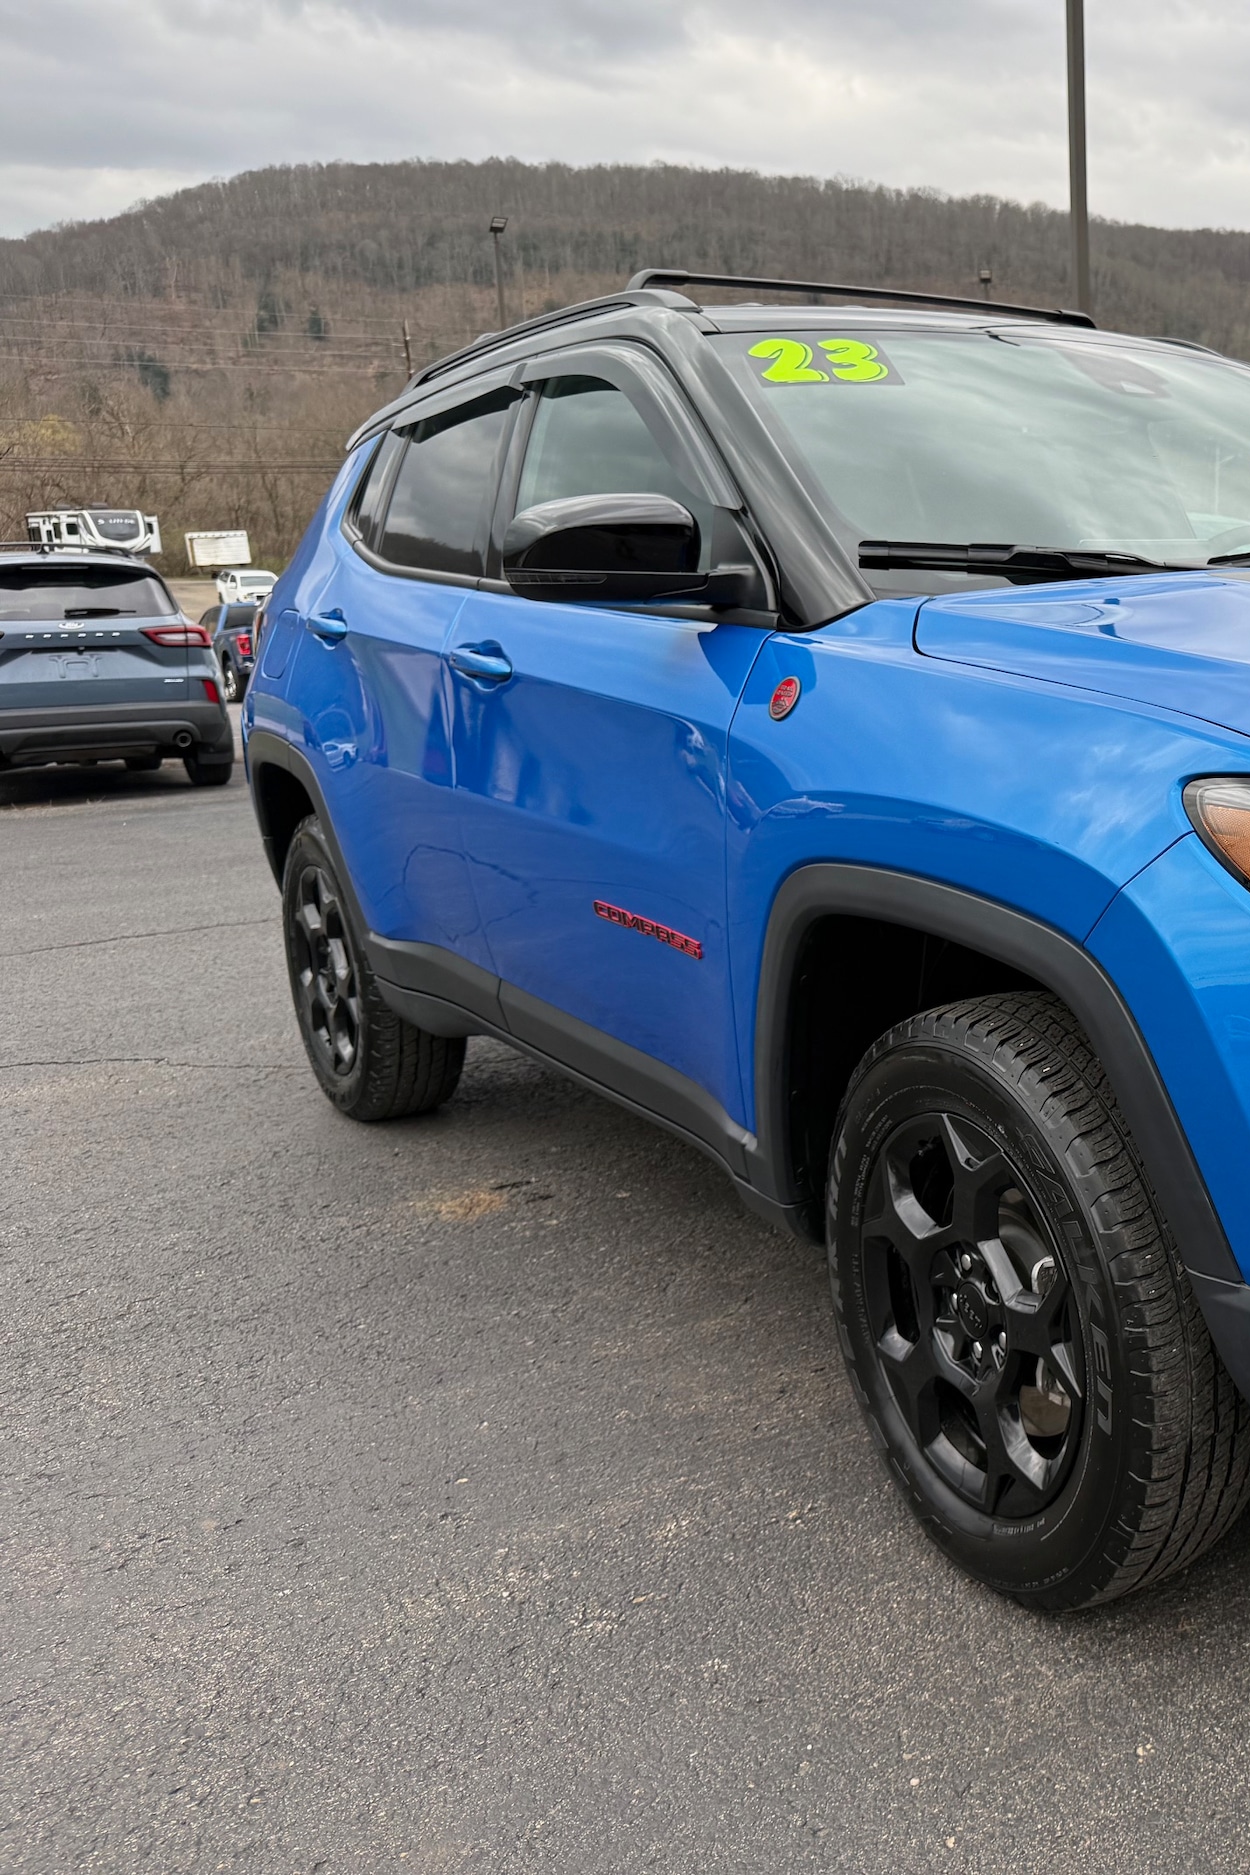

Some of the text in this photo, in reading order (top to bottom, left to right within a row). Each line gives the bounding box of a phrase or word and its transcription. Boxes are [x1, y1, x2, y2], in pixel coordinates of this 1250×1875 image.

[747, 338, 889, 383] 23
[593, 900, 702, 960] COMPASS
[1016, 1126, 1113, 1437] FALKEN
